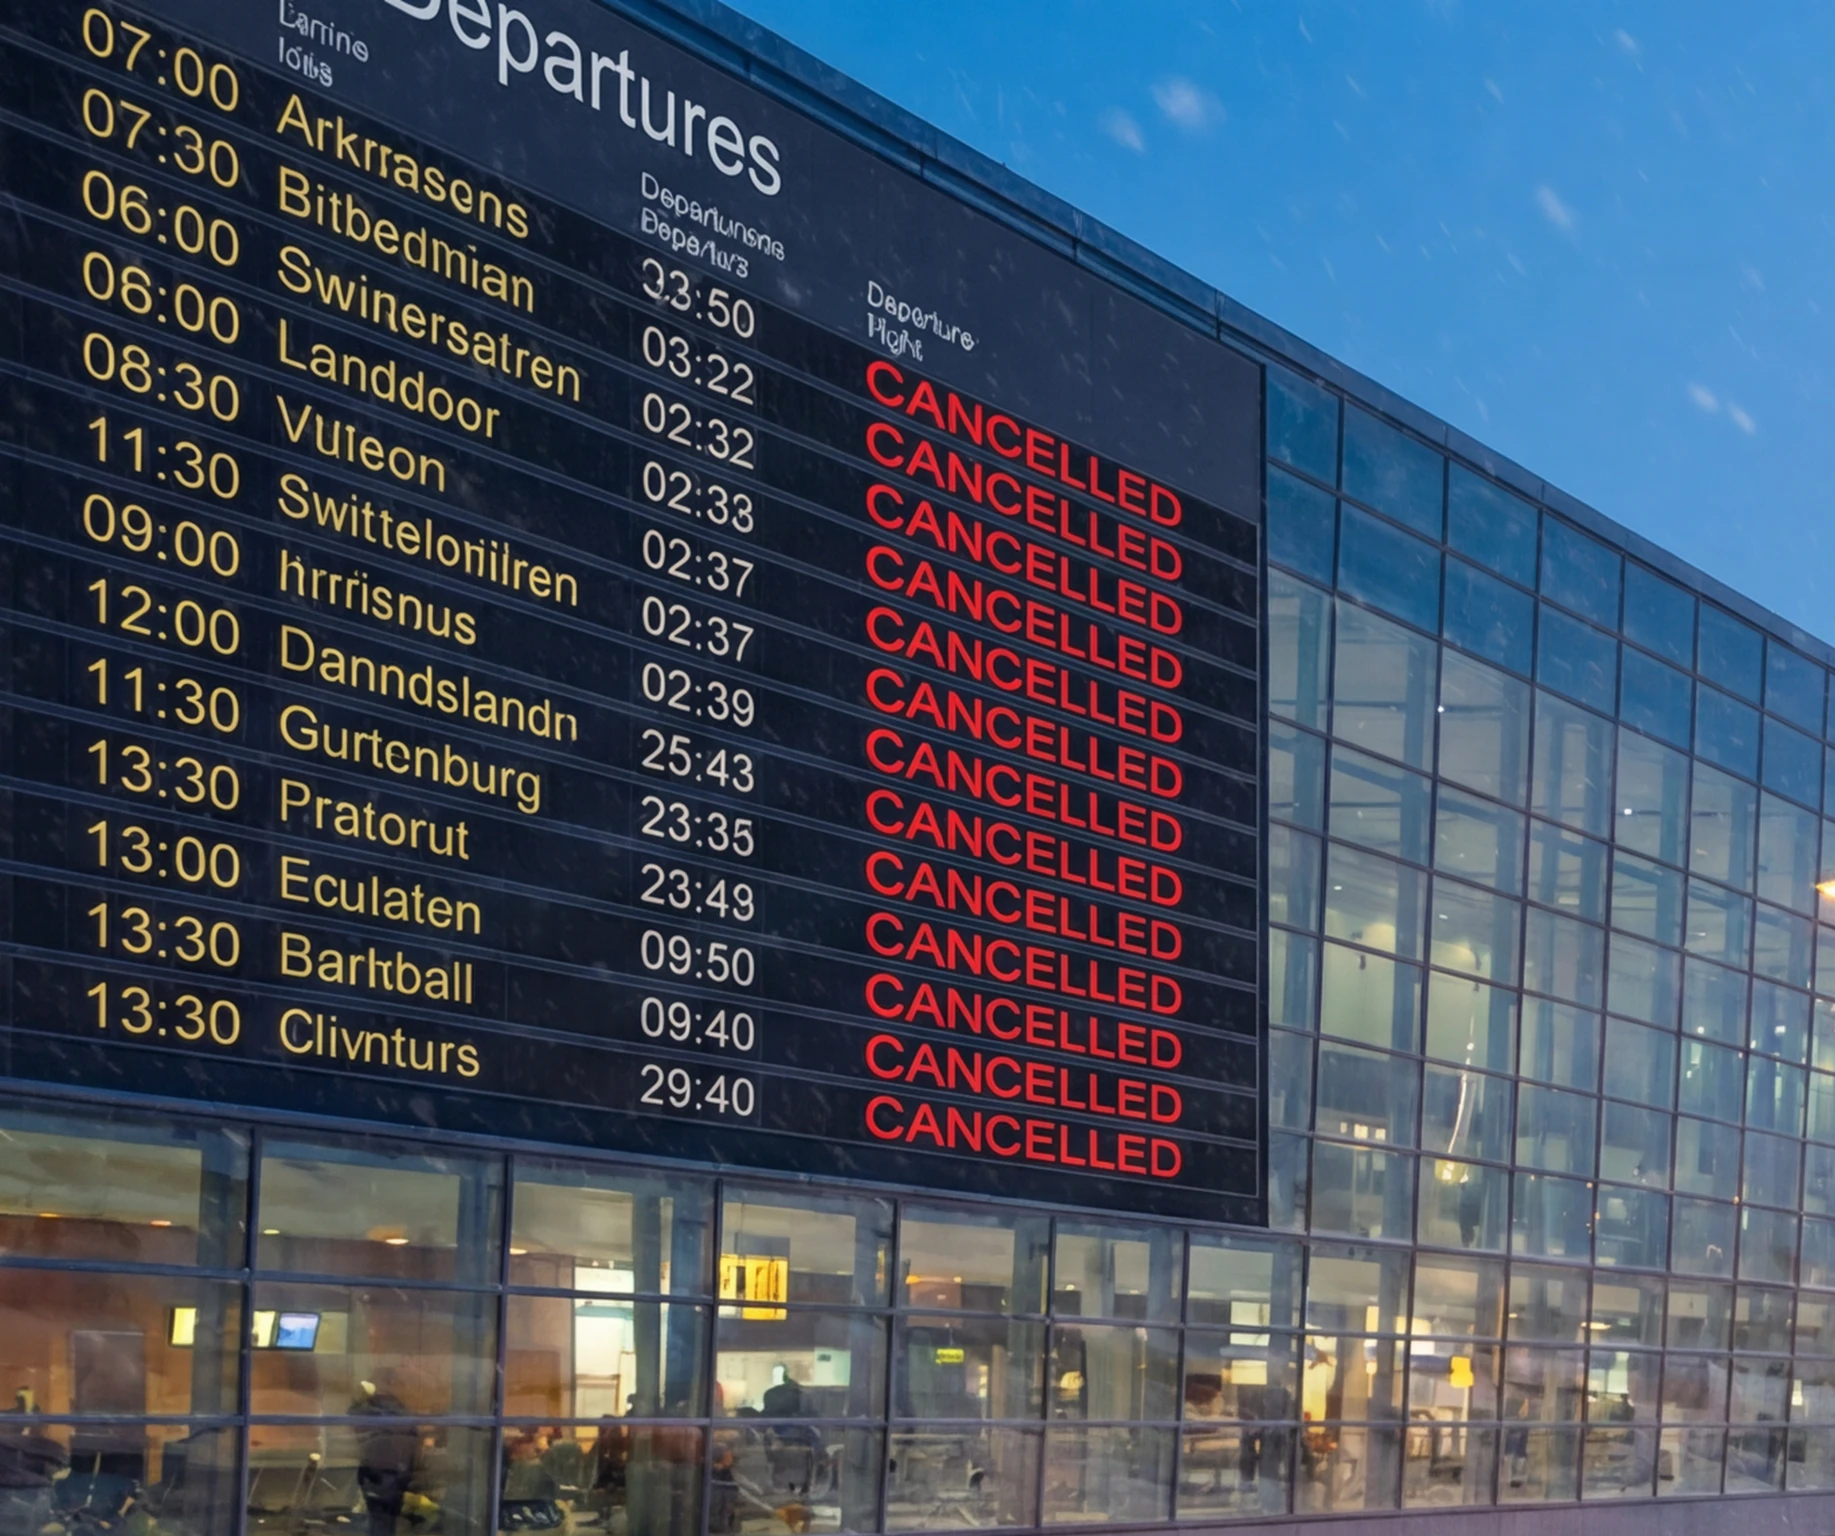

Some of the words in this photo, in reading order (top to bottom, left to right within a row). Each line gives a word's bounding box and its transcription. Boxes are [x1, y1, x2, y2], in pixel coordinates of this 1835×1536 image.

[83, 9, 238, 111] 07:00
[867, 361, 1181, 526] CANCELLED
[384, 0, 782, 196] epartures
[83, 89, 238, 187] 07:30
[643, 327, 753, 404] 03:22
[867, 423, 1182, 580] CANCELLED
[83, 171, 238, 265] 06:00
[644, 393, 753, 469] 02:32
[867, 484, 1182, 634] CANCELLED
[280, 320, 499, 437] Landdoor
[644, 462, 753, 532] 02:33
[866, 546, 1182, 688] CANCELLED
[84, 333, 239, 421] 08:30
[643, 530, 753, 597] 02:37
[866, 607, 1182, 742] CANCELLED
[84, 494, 239, 576] 09:00
[643, 663, 754, 727] 02:39
[866, 729, 1182, 851] CANCELLED
[90, 417, 239, 498] 11:30
[643, 596, 753, 661] 02:37
[866, 668, 1182, 797] CANCELLED
[88, 659, 239, 732] 11:30
[280, 705, 540, 814] Gurtenburg
[642, 796, 753, 856] 23:35
[866, 851, 1181, 960] CANCELLED
[89, 579, 239, 654] 12:00
[642, 729, 754, 792] 25:43
[866, 790, 1182, 906] CANCELLED
[89, 740, 239, 810] 13:30
[282, 779, 469, 859] Pratorut
[866, 913, 1182, 1014] CANCELLED
[88, 821, 239, 887] 13:00
[282, 856, 480, 933] Eculaten
[641, 930, 754, 985] 09:50
[866, 974, 1181, 1068] CANCELLED
[88, 982, 240, 1044] 13:30
[280, 1009, 479, 1076] Clivnturs
[641, 1064, 754, 1116] 29:40
[866, 1096, 1181, 1177] CANCELLED
[89, 903, 239, 966] 13:30
[641, 997, 754, 1050] 09:40
[866, 1035, 1182, 1123] CANCELLED
